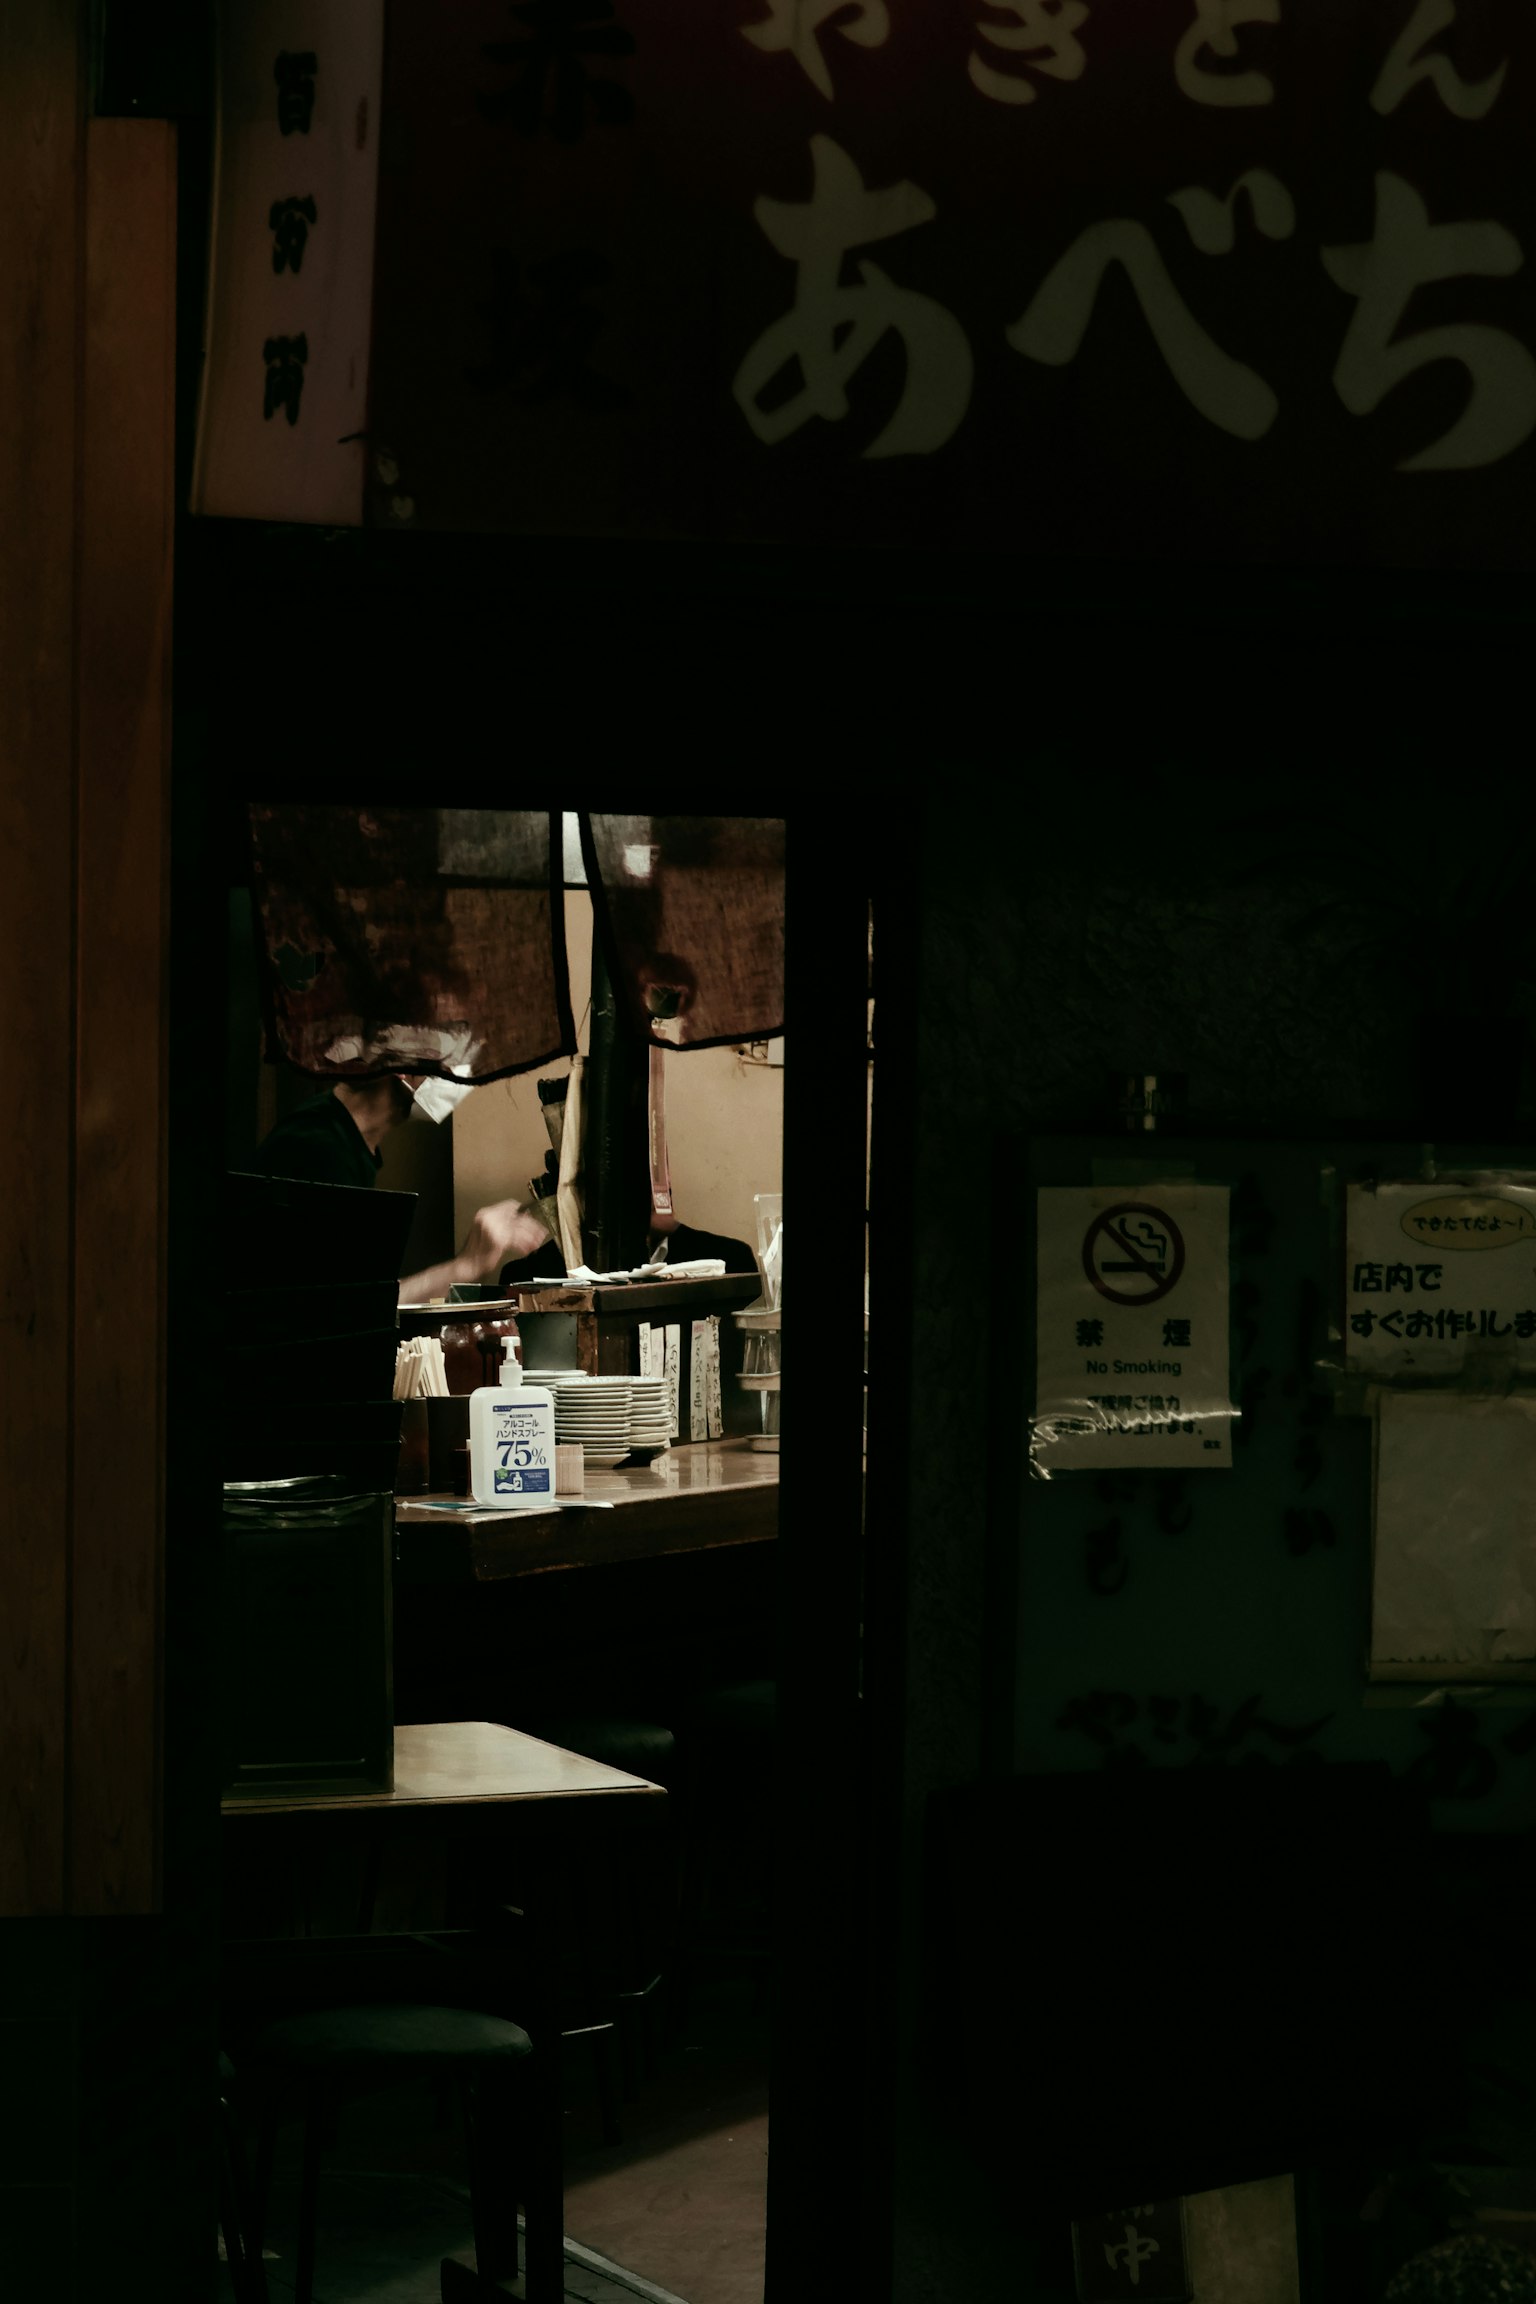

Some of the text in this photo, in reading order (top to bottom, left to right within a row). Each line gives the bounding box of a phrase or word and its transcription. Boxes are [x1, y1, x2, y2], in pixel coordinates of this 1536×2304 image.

[732, 132, 1536, 472] あべち
[1353, 1262, 1443, 1293] 店内で
[1350, 1309, 1536, 1339] すぐお作りしま
[1086, 1360, 1182, 1377] No Smoking
[495, 1429, 546, 1440] ハンドスプレー
[502, 1418, 540, 1429] アルコール
[496, 1440, 547, 1467] 75%
